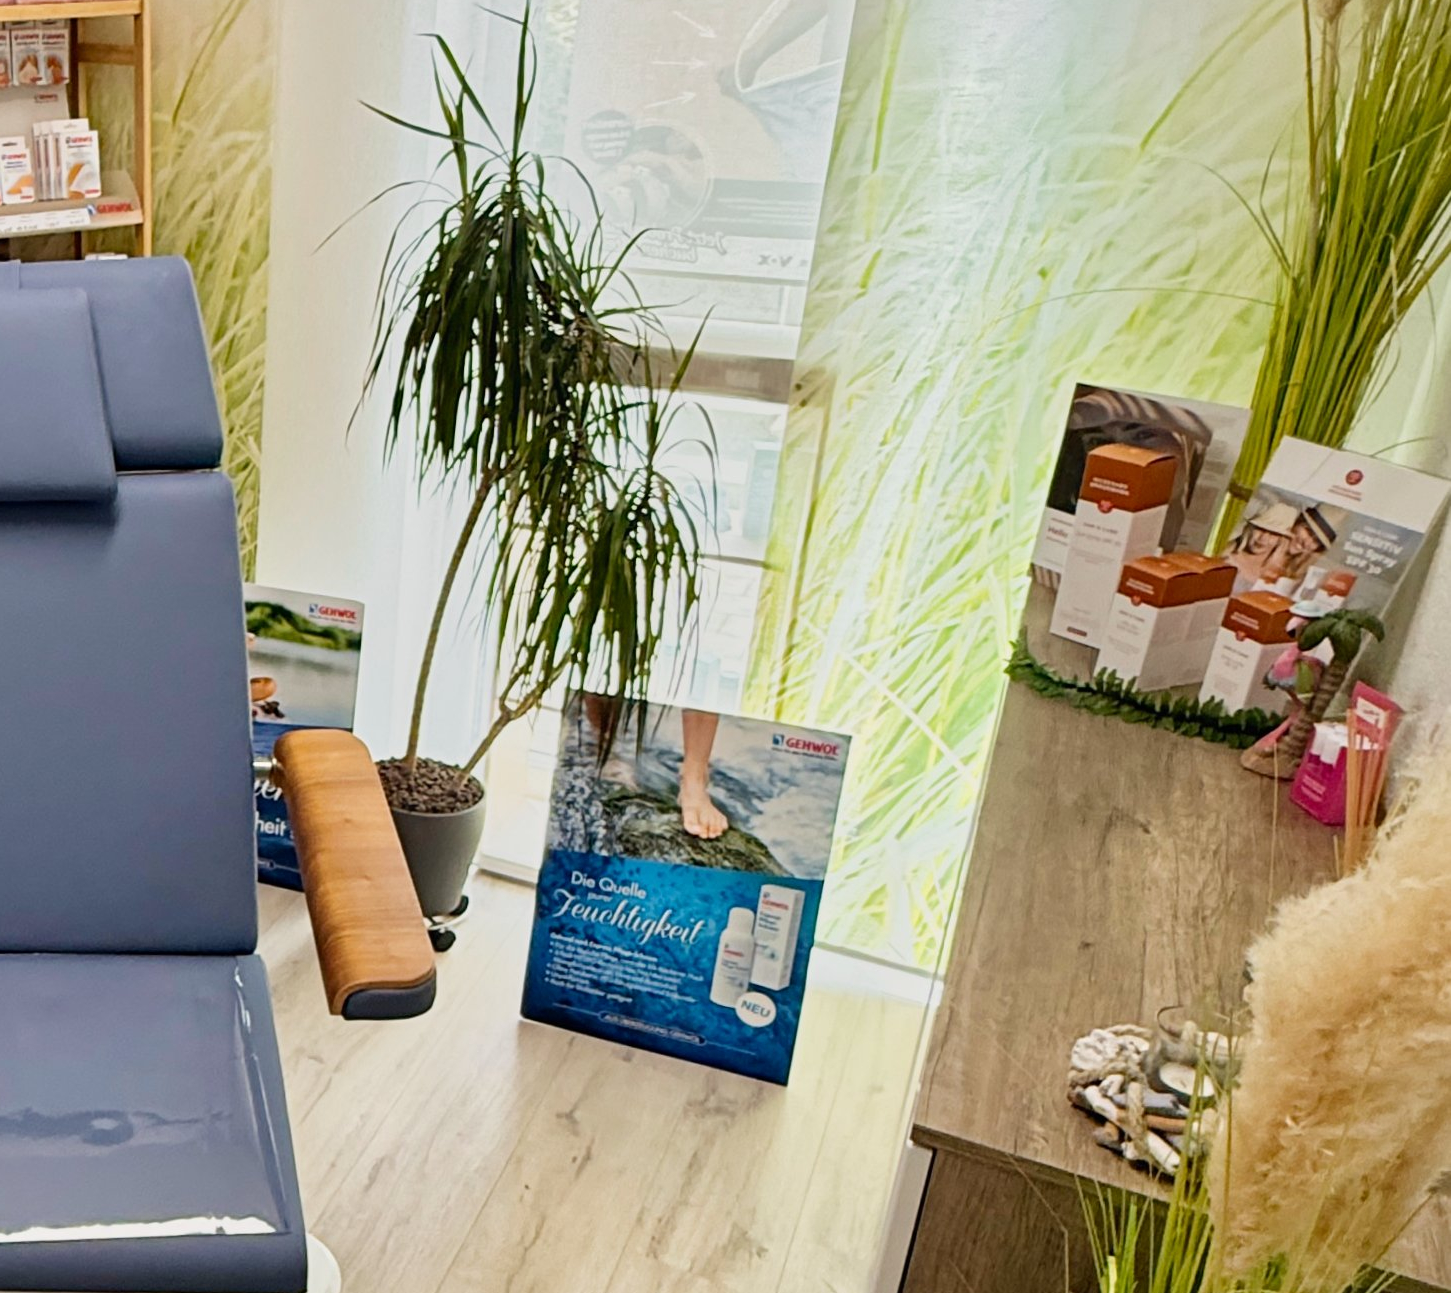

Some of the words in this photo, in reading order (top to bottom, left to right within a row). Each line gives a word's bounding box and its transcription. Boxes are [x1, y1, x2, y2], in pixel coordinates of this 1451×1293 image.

[785, 736, 839, 756] GEHWOL
[570, 870, 596, 889] Die
[598, 877, 647, 900] Quelle
[552, 888, 705, 945] Feuchtigkeit
[740, 999, 771, 1019] NEU
